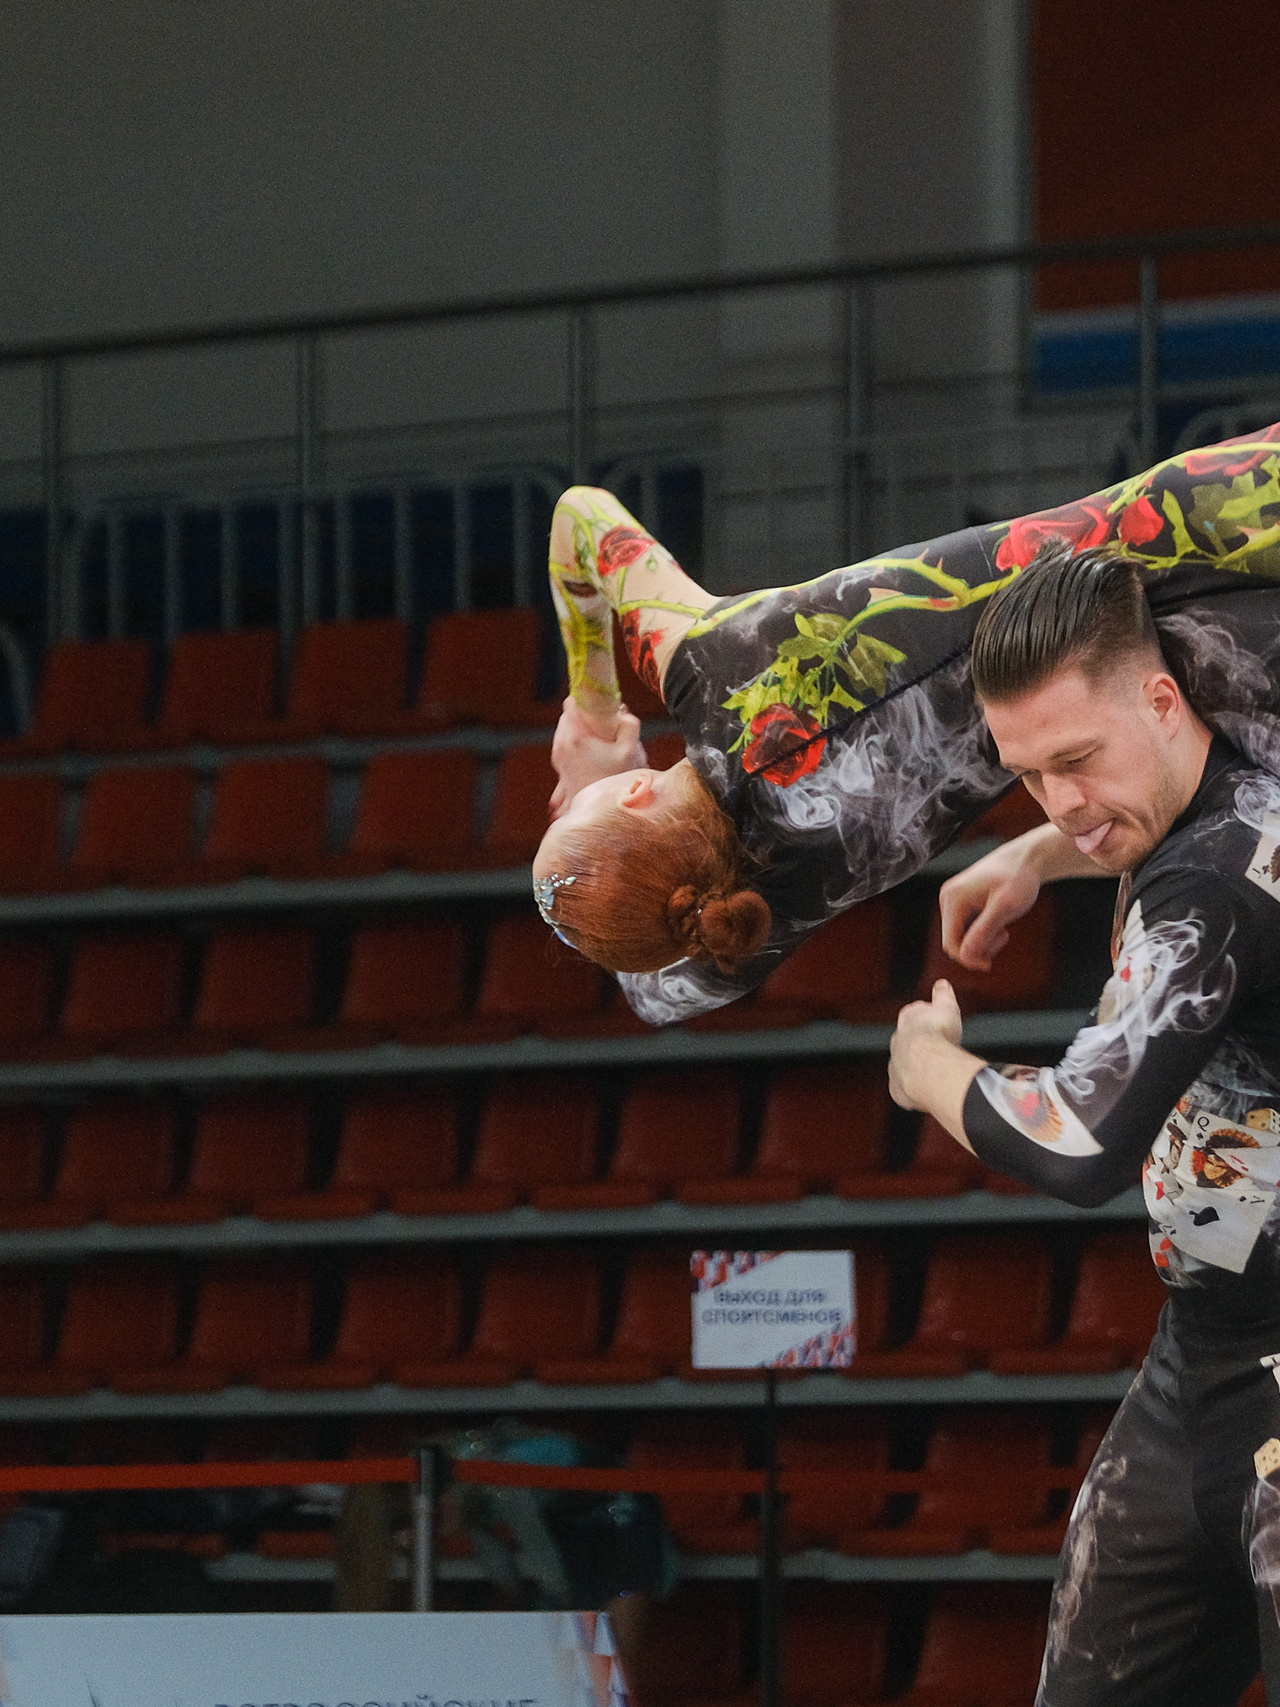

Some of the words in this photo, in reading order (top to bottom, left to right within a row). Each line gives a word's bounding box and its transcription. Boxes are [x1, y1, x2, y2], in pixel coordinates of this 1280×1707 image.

[714, 1288, 779, 1305] ВЫХОД
[786, 1288, 826, 1305] ДЛЯ
[701, 1308, 842, 1324] СПОРТСМЕНОВ
